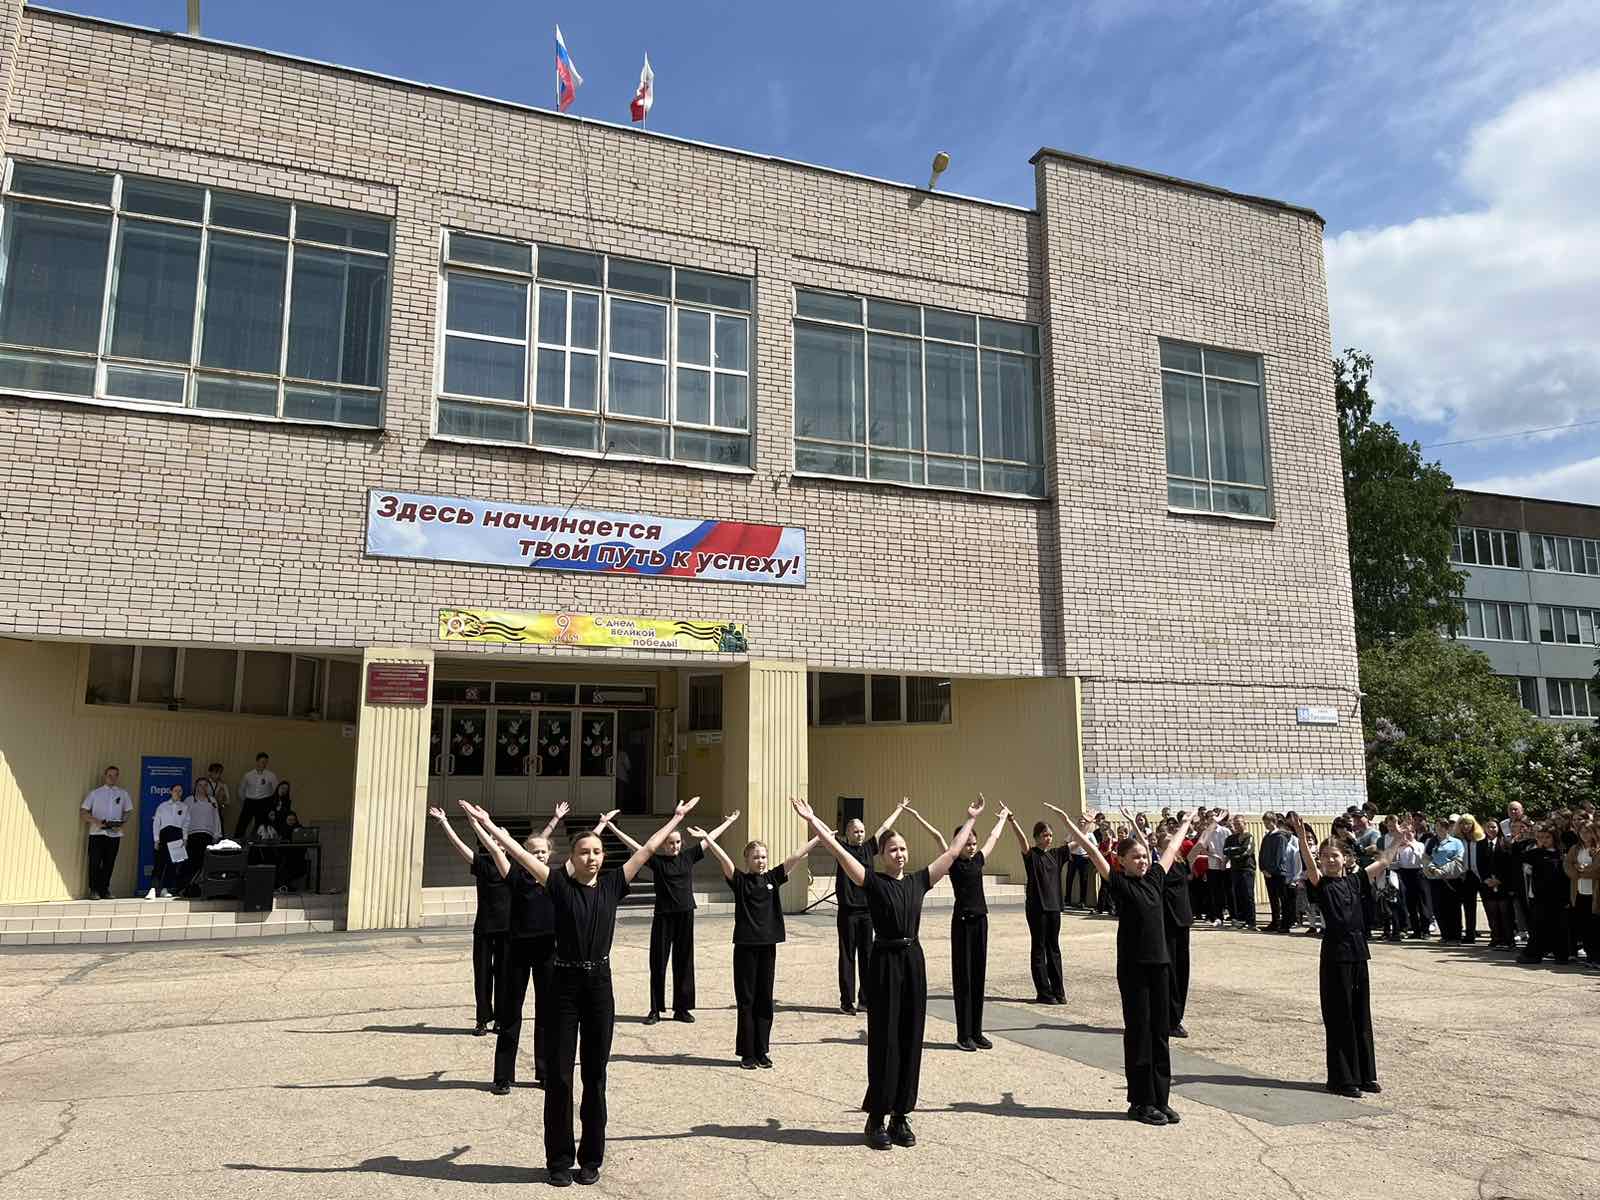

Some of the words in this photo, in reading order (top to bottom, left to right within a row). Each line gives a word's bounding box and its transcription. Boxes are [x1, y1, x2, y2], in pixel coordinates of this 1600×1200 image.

[376, 495, 474, 525] Здесь
[482, 510, 662, 541] начинается
[518, 537, 590, 561] твой
[598, 545, 664, 568] путь
[672, 551, 689, 568] к
[695, 552, 801, 579] успеху!
[556, 615, 570, 640] 9
[594, 617, 603, 626] С
[606, 619, 635, 628] днем
[610, 627, 656, 637] великой
[632, 638, 678, 648] победы!
